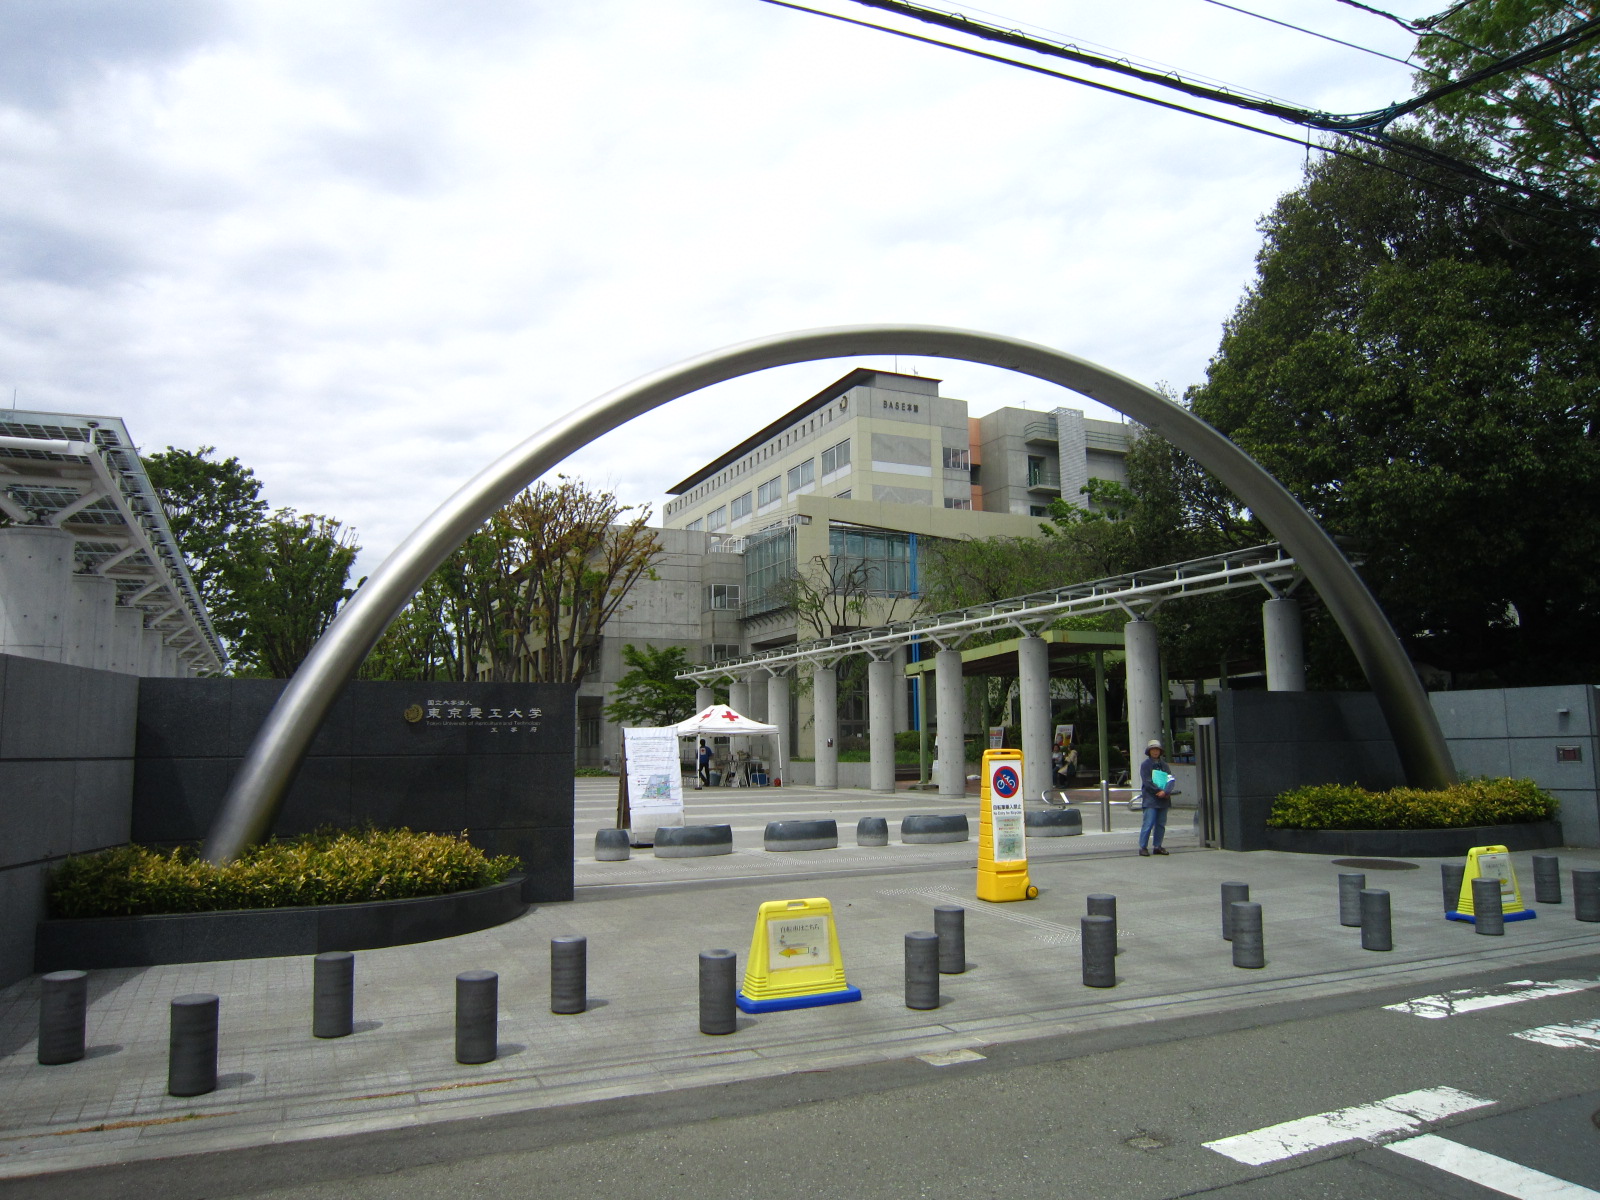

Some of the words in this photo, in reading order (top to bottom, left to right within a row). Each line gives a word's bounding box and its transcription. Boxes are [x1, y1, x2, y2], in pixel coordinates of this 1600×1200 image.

[427, 708, 542, 718] 東京農工大学
